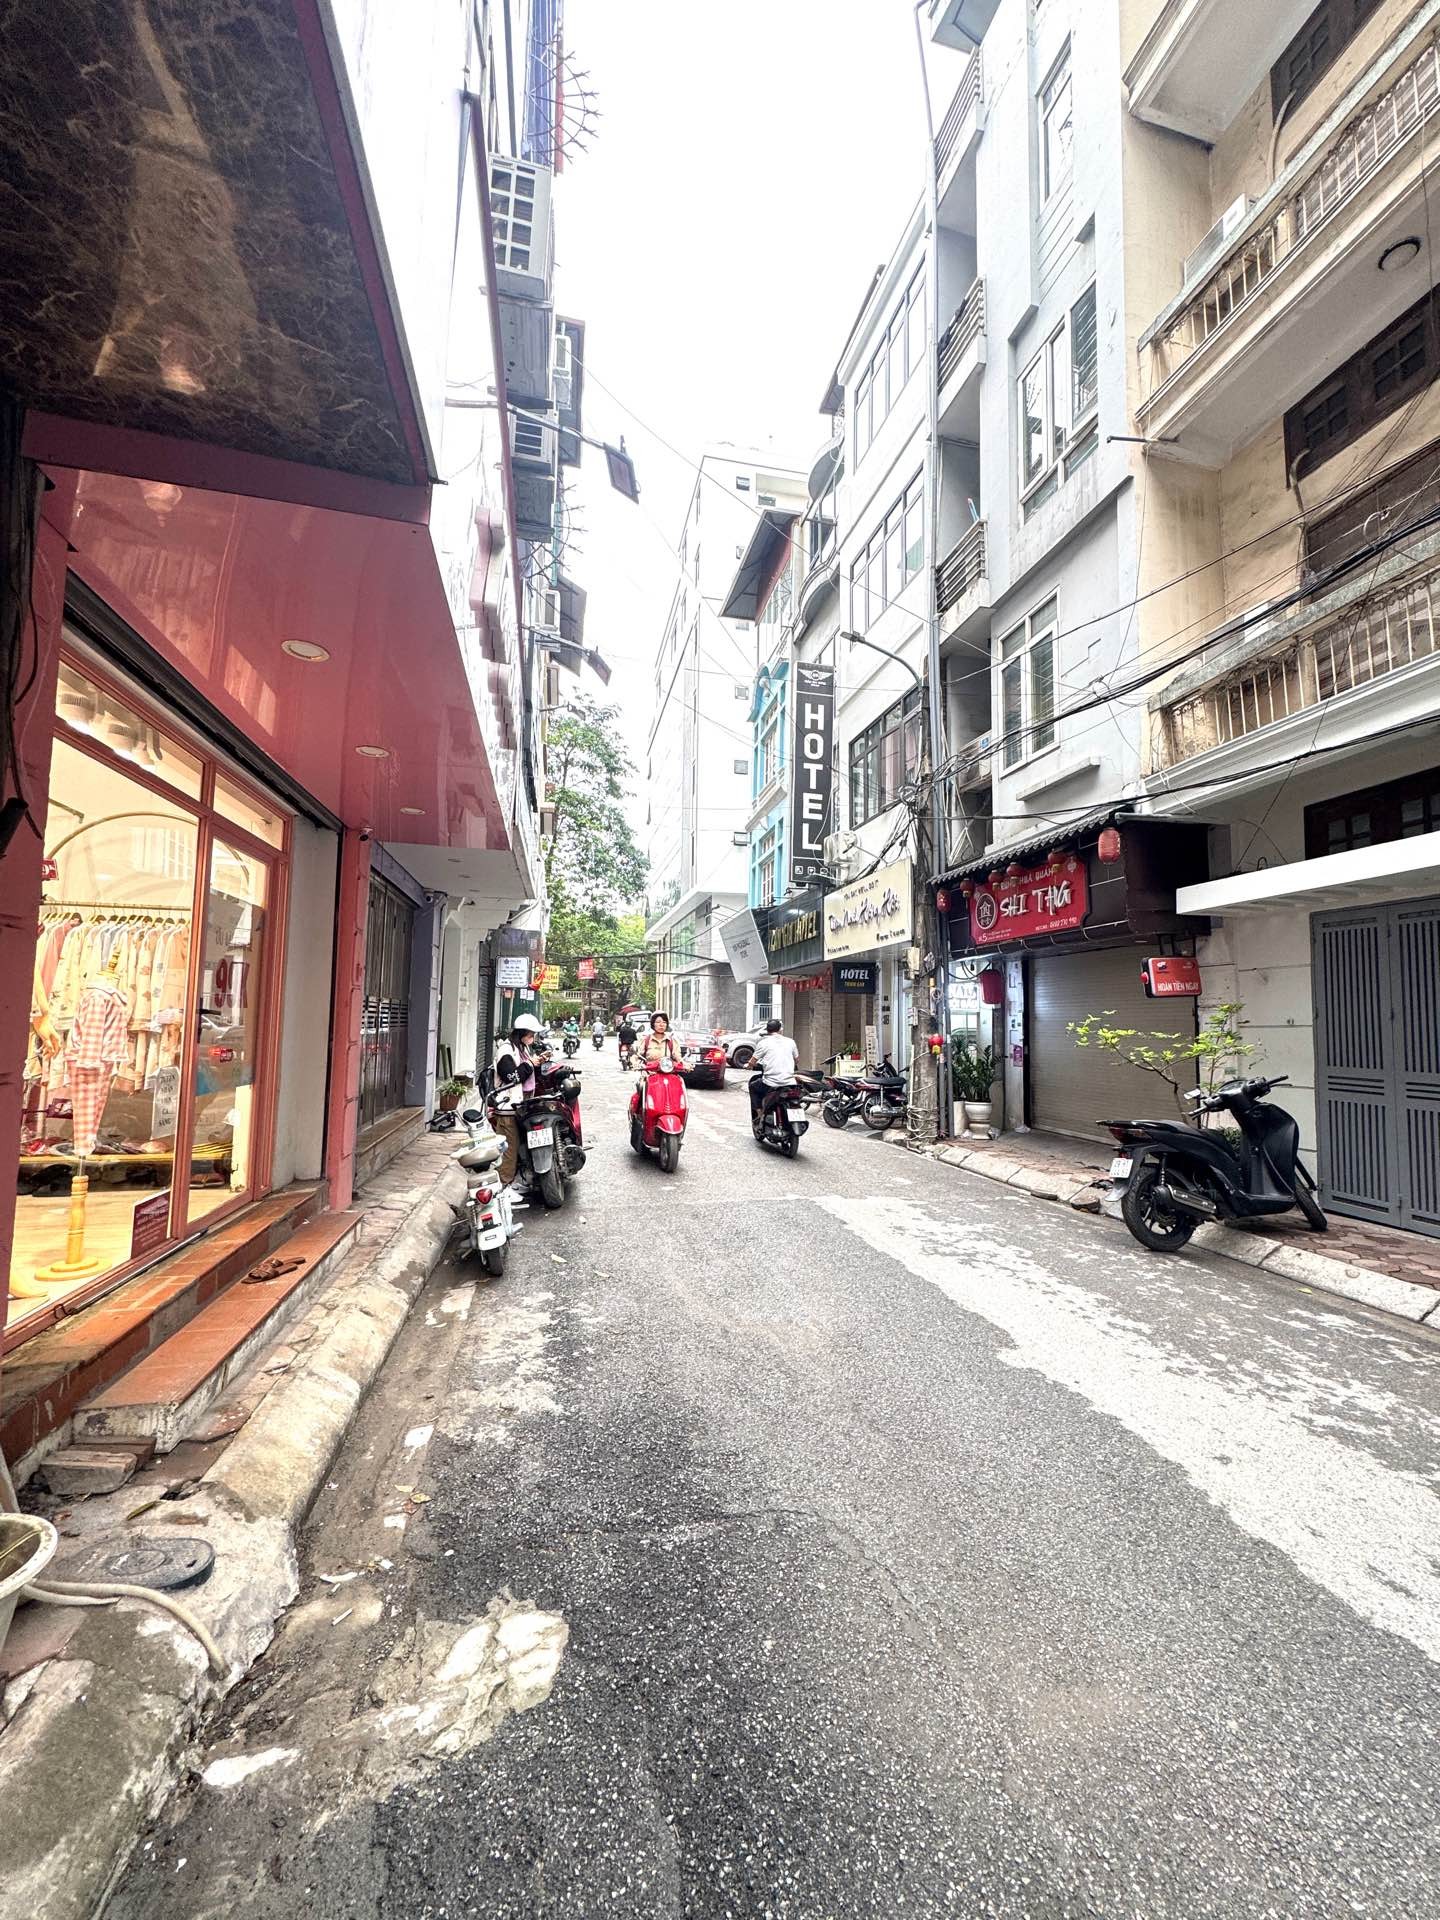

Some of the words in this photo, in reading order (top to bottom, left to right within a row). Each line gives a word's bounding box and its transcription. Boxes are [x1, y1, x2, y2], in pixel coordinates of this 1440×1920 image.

[802, 703, 825, 851] HOTEL
[1000, 893, 1029, 917] SHI
[840, 969, 870, 980] HOTEL
